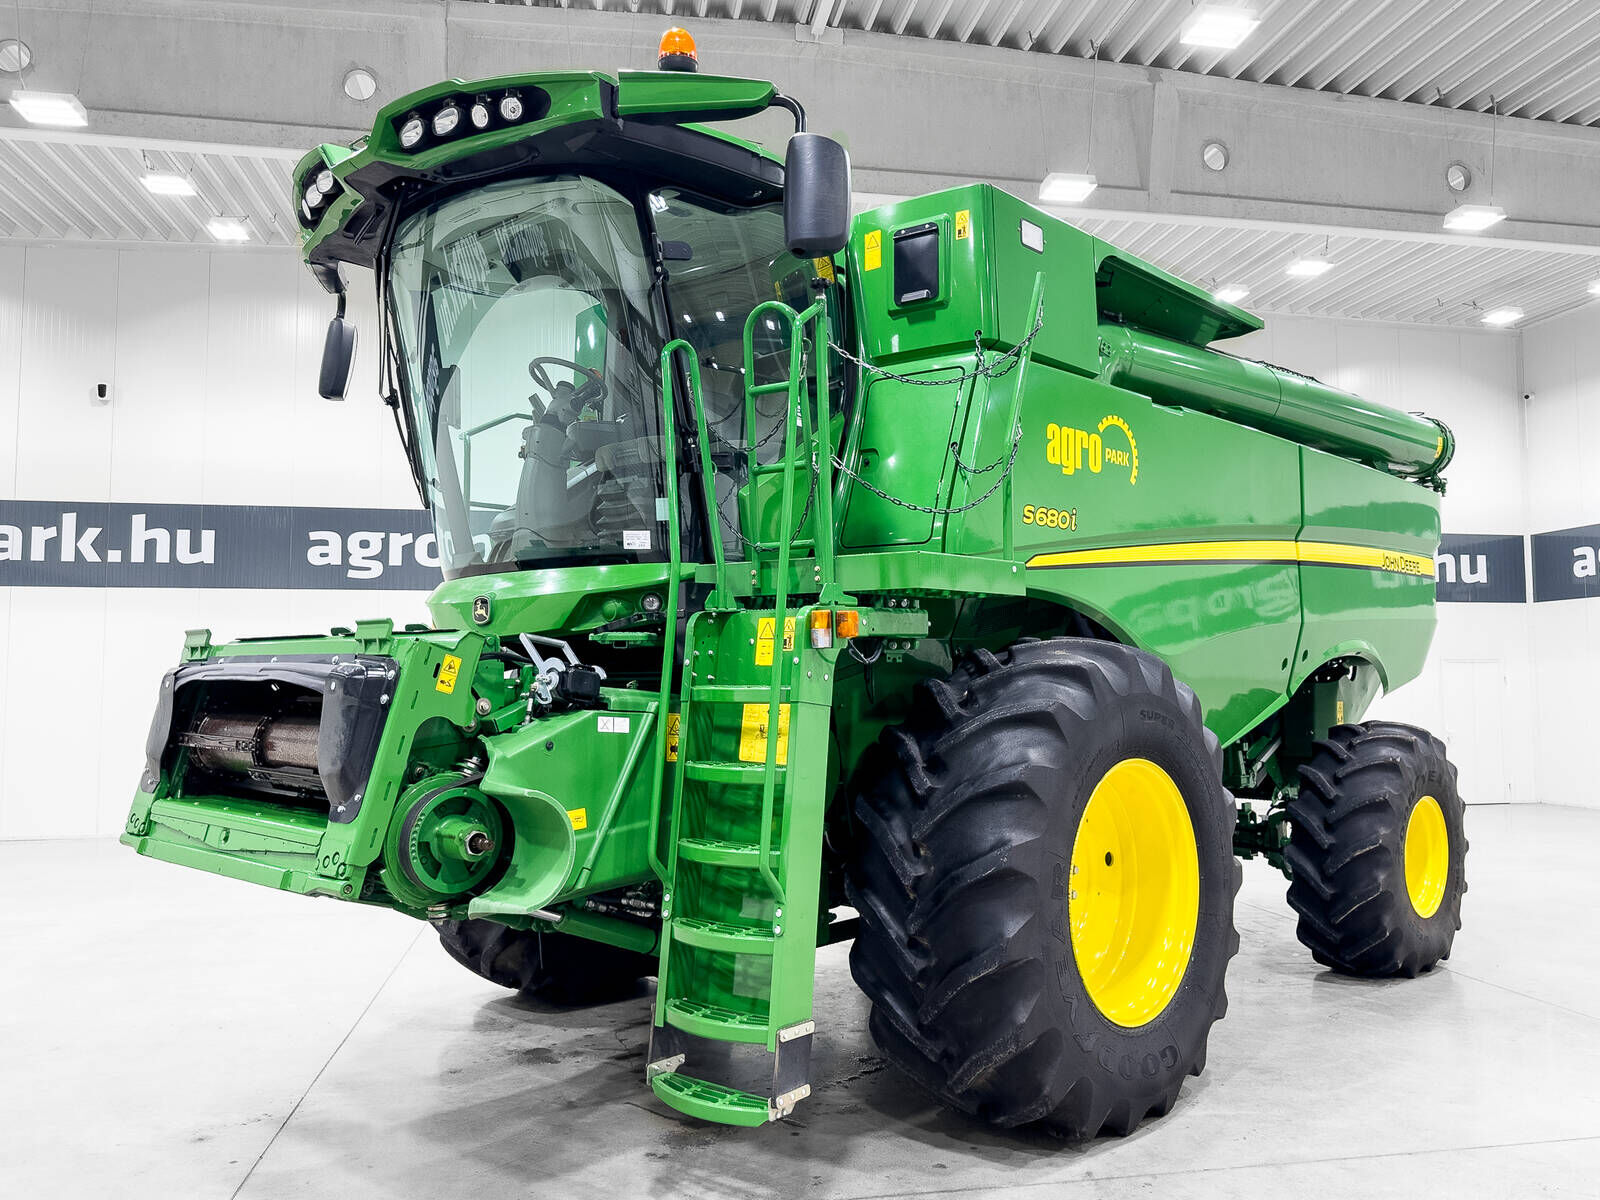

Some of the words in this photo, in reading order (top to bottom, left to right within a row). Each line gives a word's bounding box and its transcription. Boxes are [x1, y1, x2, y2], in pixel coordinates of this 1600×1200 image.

[1046, 422, 1102, 476] agro
[1105, 447, 1130, 467] PARK
[1022, 504, 1078, 532] S680i
[0, 512, 216, 564] ark.hu
[1382, 552, 1400, 571] JOHN
[1400, 556, 1421, 574] DEERE
[1573, 546, 1600, 578] a
